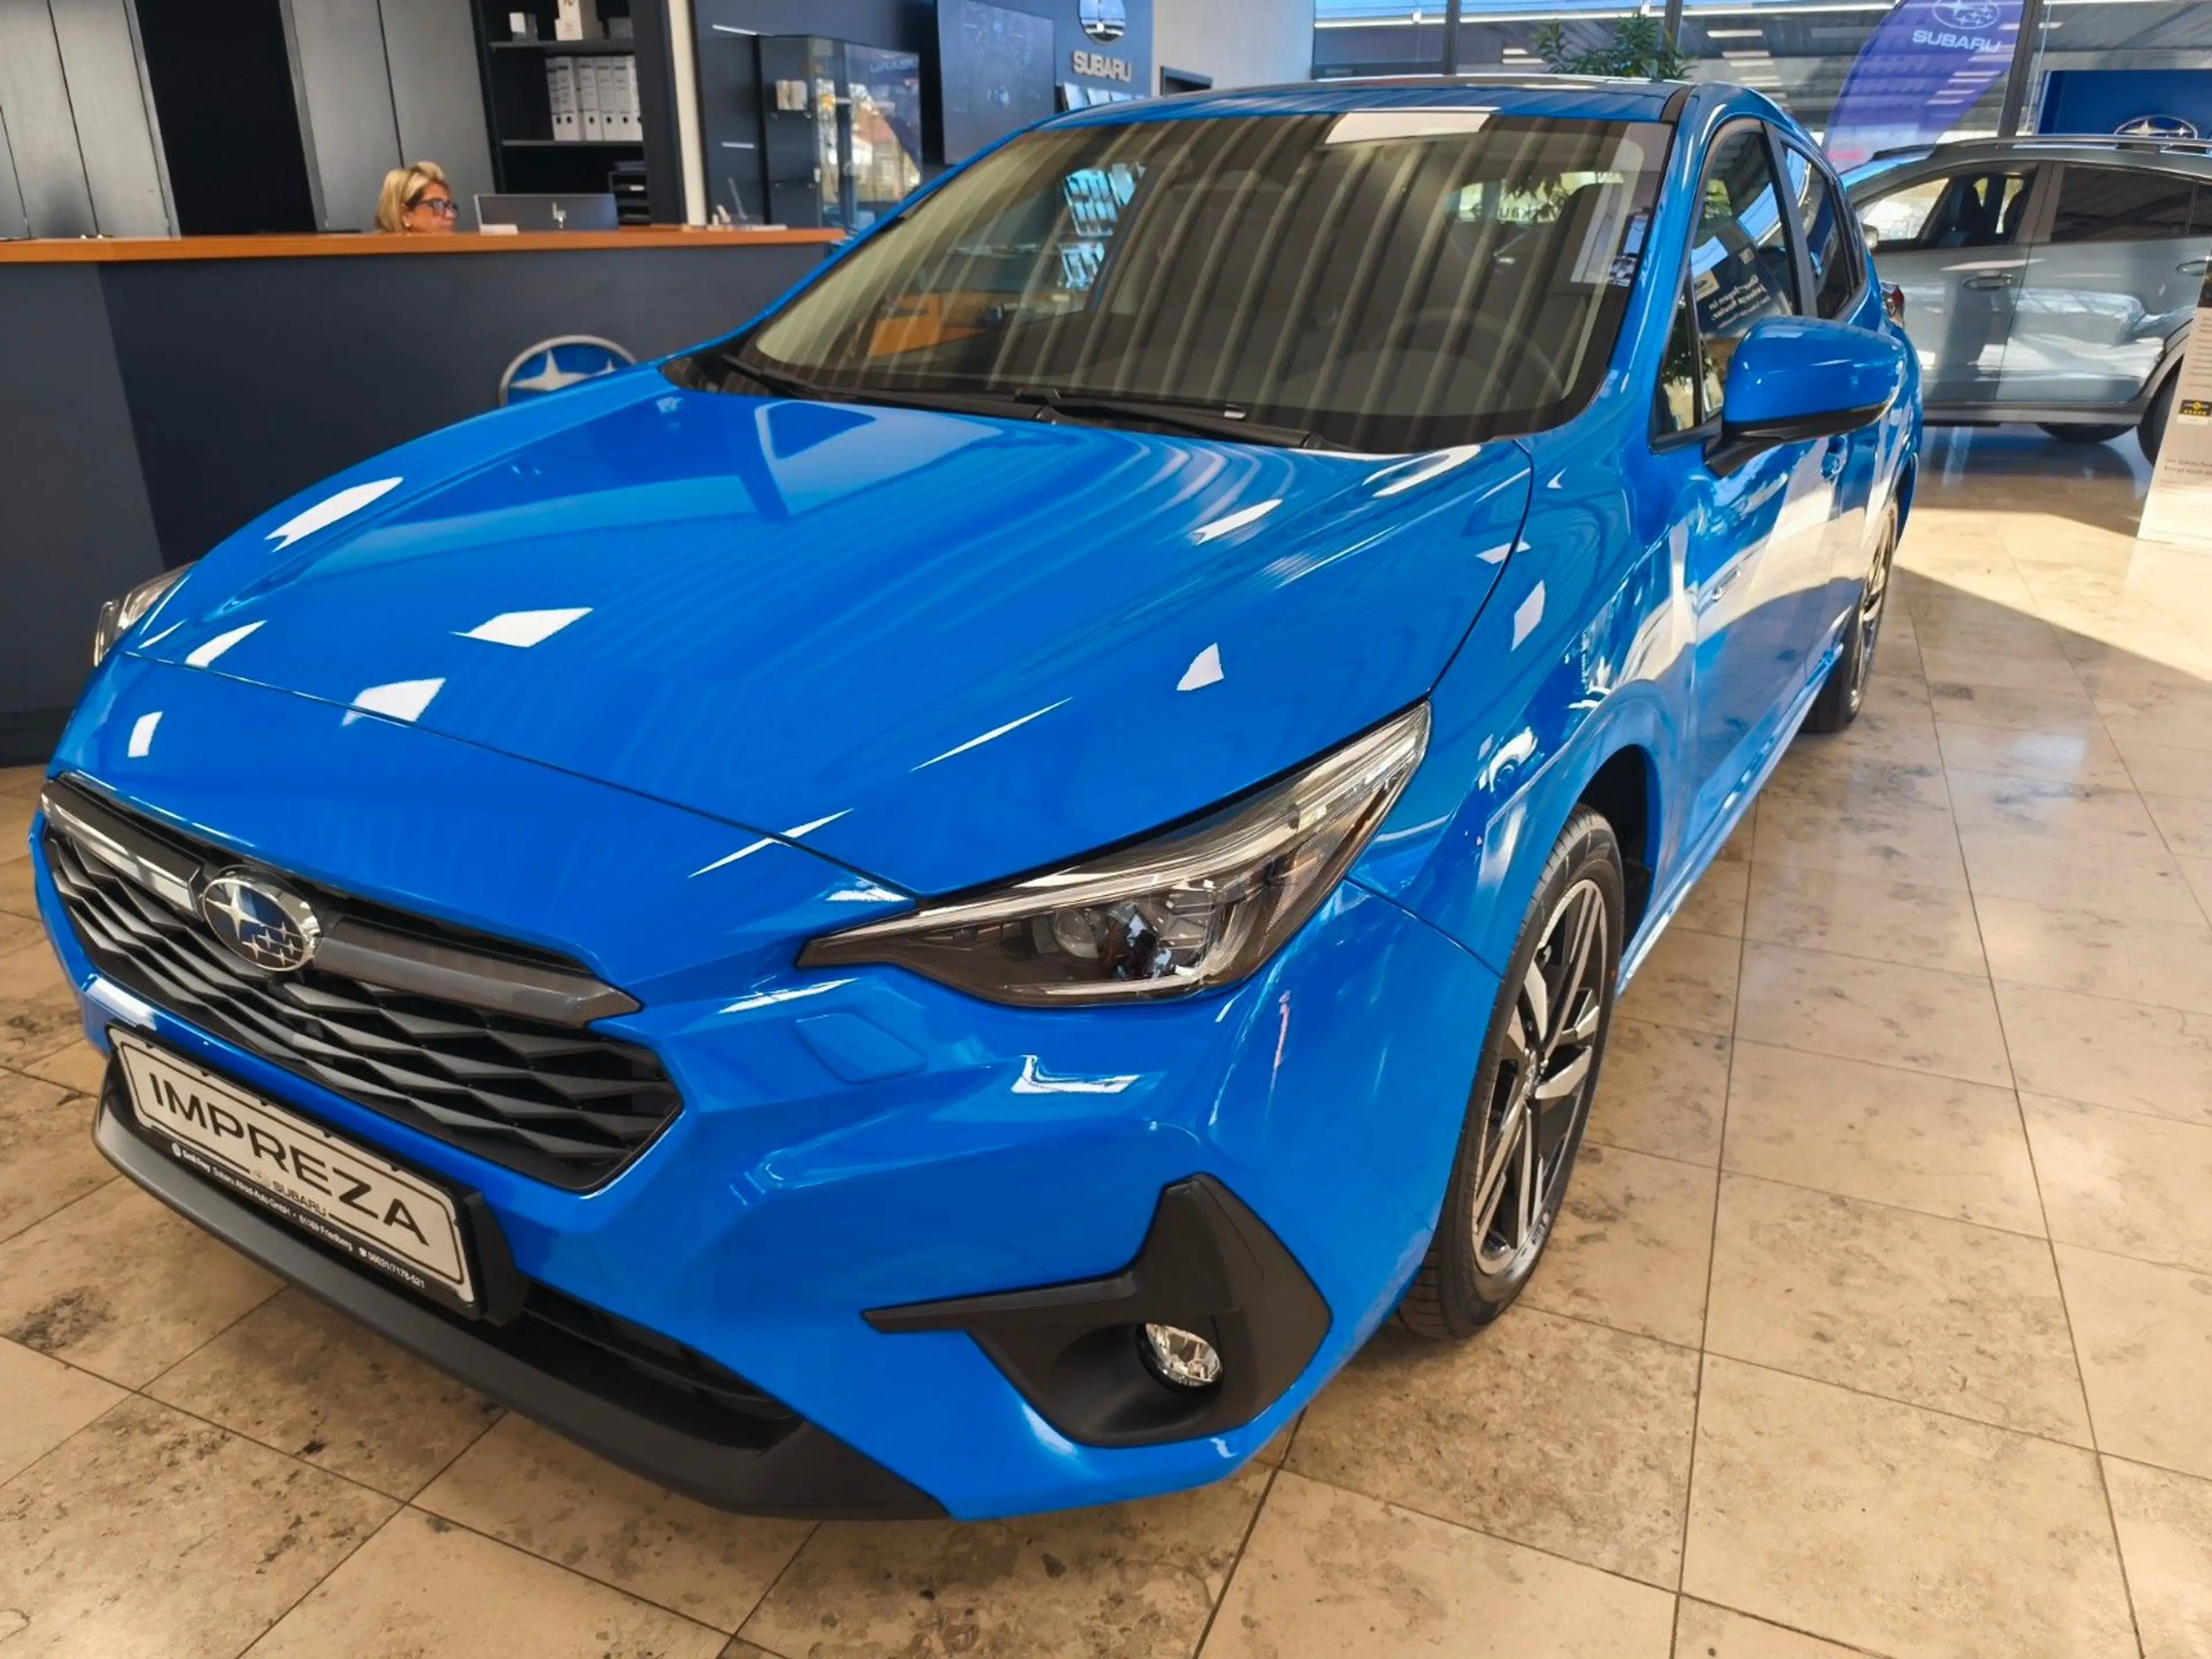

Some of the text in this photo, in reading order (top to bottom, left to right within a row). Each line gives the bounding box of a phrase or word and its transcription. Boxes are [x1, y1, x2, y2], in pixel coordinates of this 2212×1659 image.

[1912, 30, 2001, 53] SUBARU
[1073, 50, 1132, 82] SUBARU
[149, 1072, 429, 1247] IMPREZA
[273, 1180, 327, 1218] SUBARU
